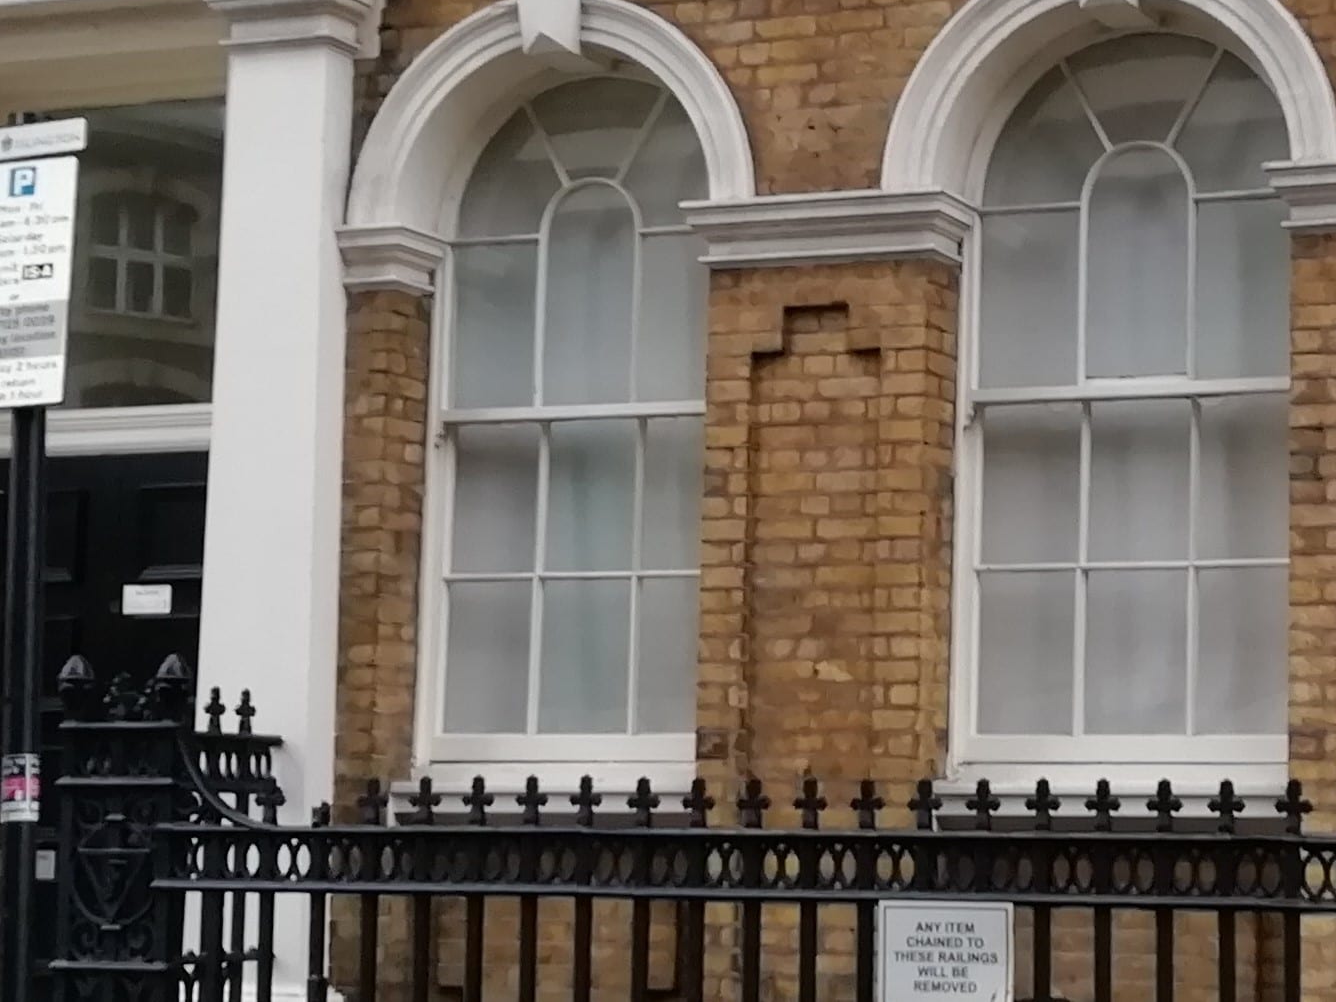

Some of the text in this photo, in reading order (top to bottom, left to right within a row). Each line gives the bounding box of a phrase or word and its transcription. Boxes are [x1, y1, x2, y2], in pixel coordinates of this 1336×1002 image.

[915, 921, 974, 933] ANY ITEM
[906, 936, 984, 948] CHAINED TO
[894, 951, 998, 963] THESE RAILINGS
[918, 966, 969, 978] WILL BE
[914, 980, 977, 992] REMOVED
